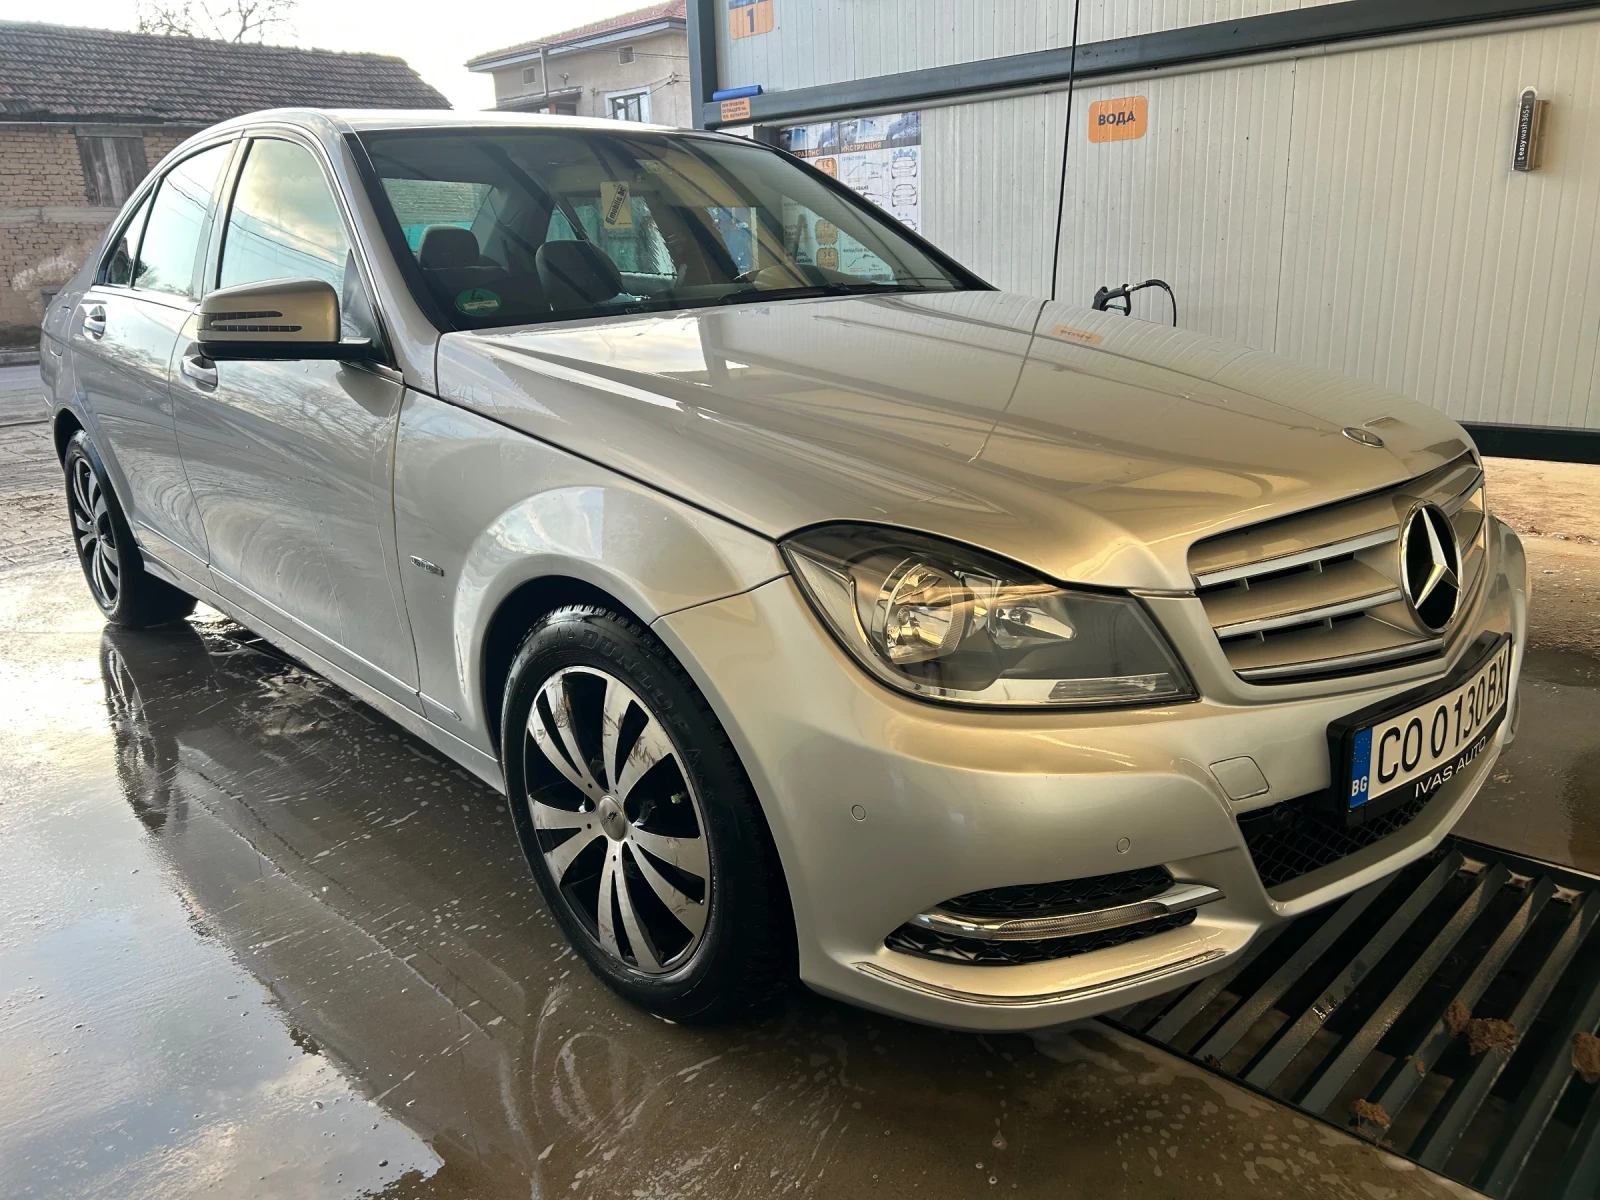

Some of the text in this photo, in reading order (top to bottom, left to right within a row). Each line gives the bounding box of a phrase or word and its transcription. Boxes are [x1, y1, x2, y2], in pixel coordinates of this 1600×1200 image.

[746, 7, 755, 33] 1
[1097, 110, 1136, 126] ВОДА
[840, 141, 882, 153] ИНСТРУКЦИЯ
[580, 628, 692, 736] DUNLOP
[1414, 735, 1487, 798] IVAS AUTO
[1351, 775, 1368, 797] BG
